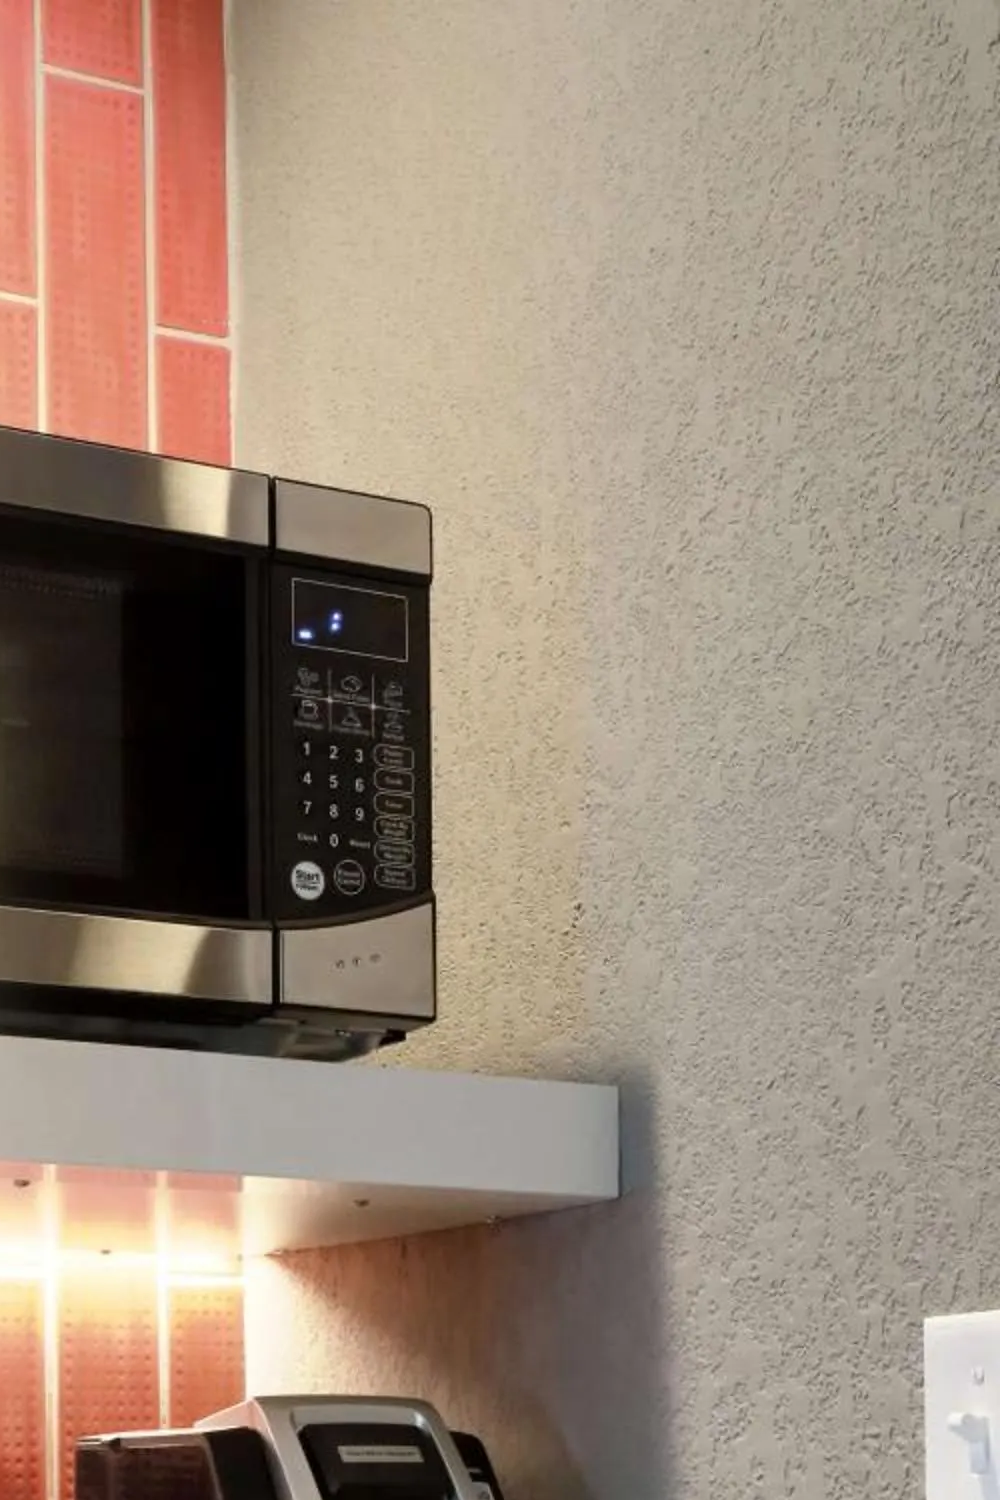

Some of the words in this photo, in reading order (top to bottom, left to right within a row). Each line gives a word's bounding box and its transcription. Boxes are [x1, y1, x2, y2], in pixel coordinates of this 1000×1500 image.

[303, 742, 311, 756] 1
[329, 745, 339, 760] 2
[354, 748, 364, 763] 3
[303, 771, 312, 785] 4
[329, 775, 339, 789] 5
[355, 778, 365, 793] 6
[303, 801, 312, 815] 7
[329, 803, 339, 818] 8
[355, 807, 365, 821] 9
[329, 833, 340, 848] 0
